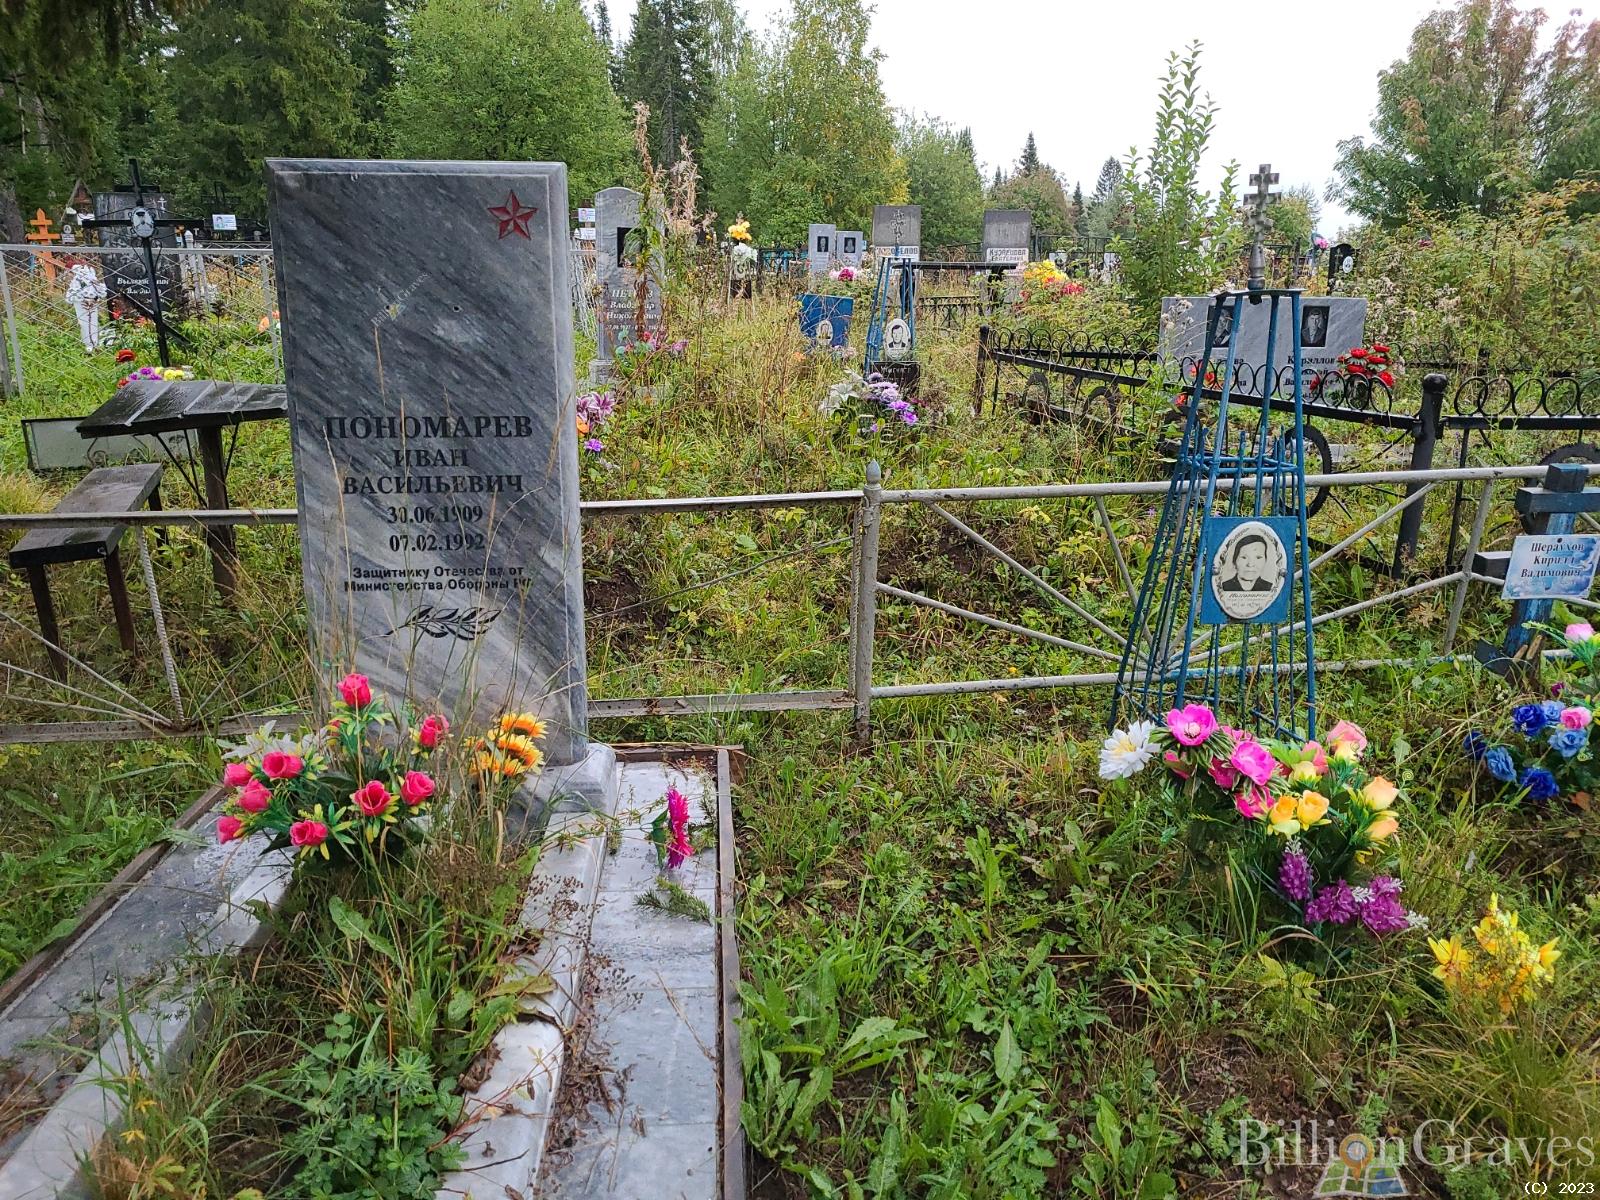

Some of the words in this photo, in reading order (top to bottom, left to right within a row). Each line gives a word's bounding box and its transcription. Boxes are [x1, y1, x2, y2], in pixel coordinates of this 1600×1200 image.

[325, 416, 533, 439] ПОНОМАРЕВ
[393, 449, 469, 467] ИВАН
[344, 475, 523, 495] ВАСИЛЬЕВИЧ
[387, 505, 483, 524] 30.06.1909
[389, 534, 486, 552] 07.02.1992
[352, 566, 430, 579] Защитнику
[508, 565, 524, 575] от
